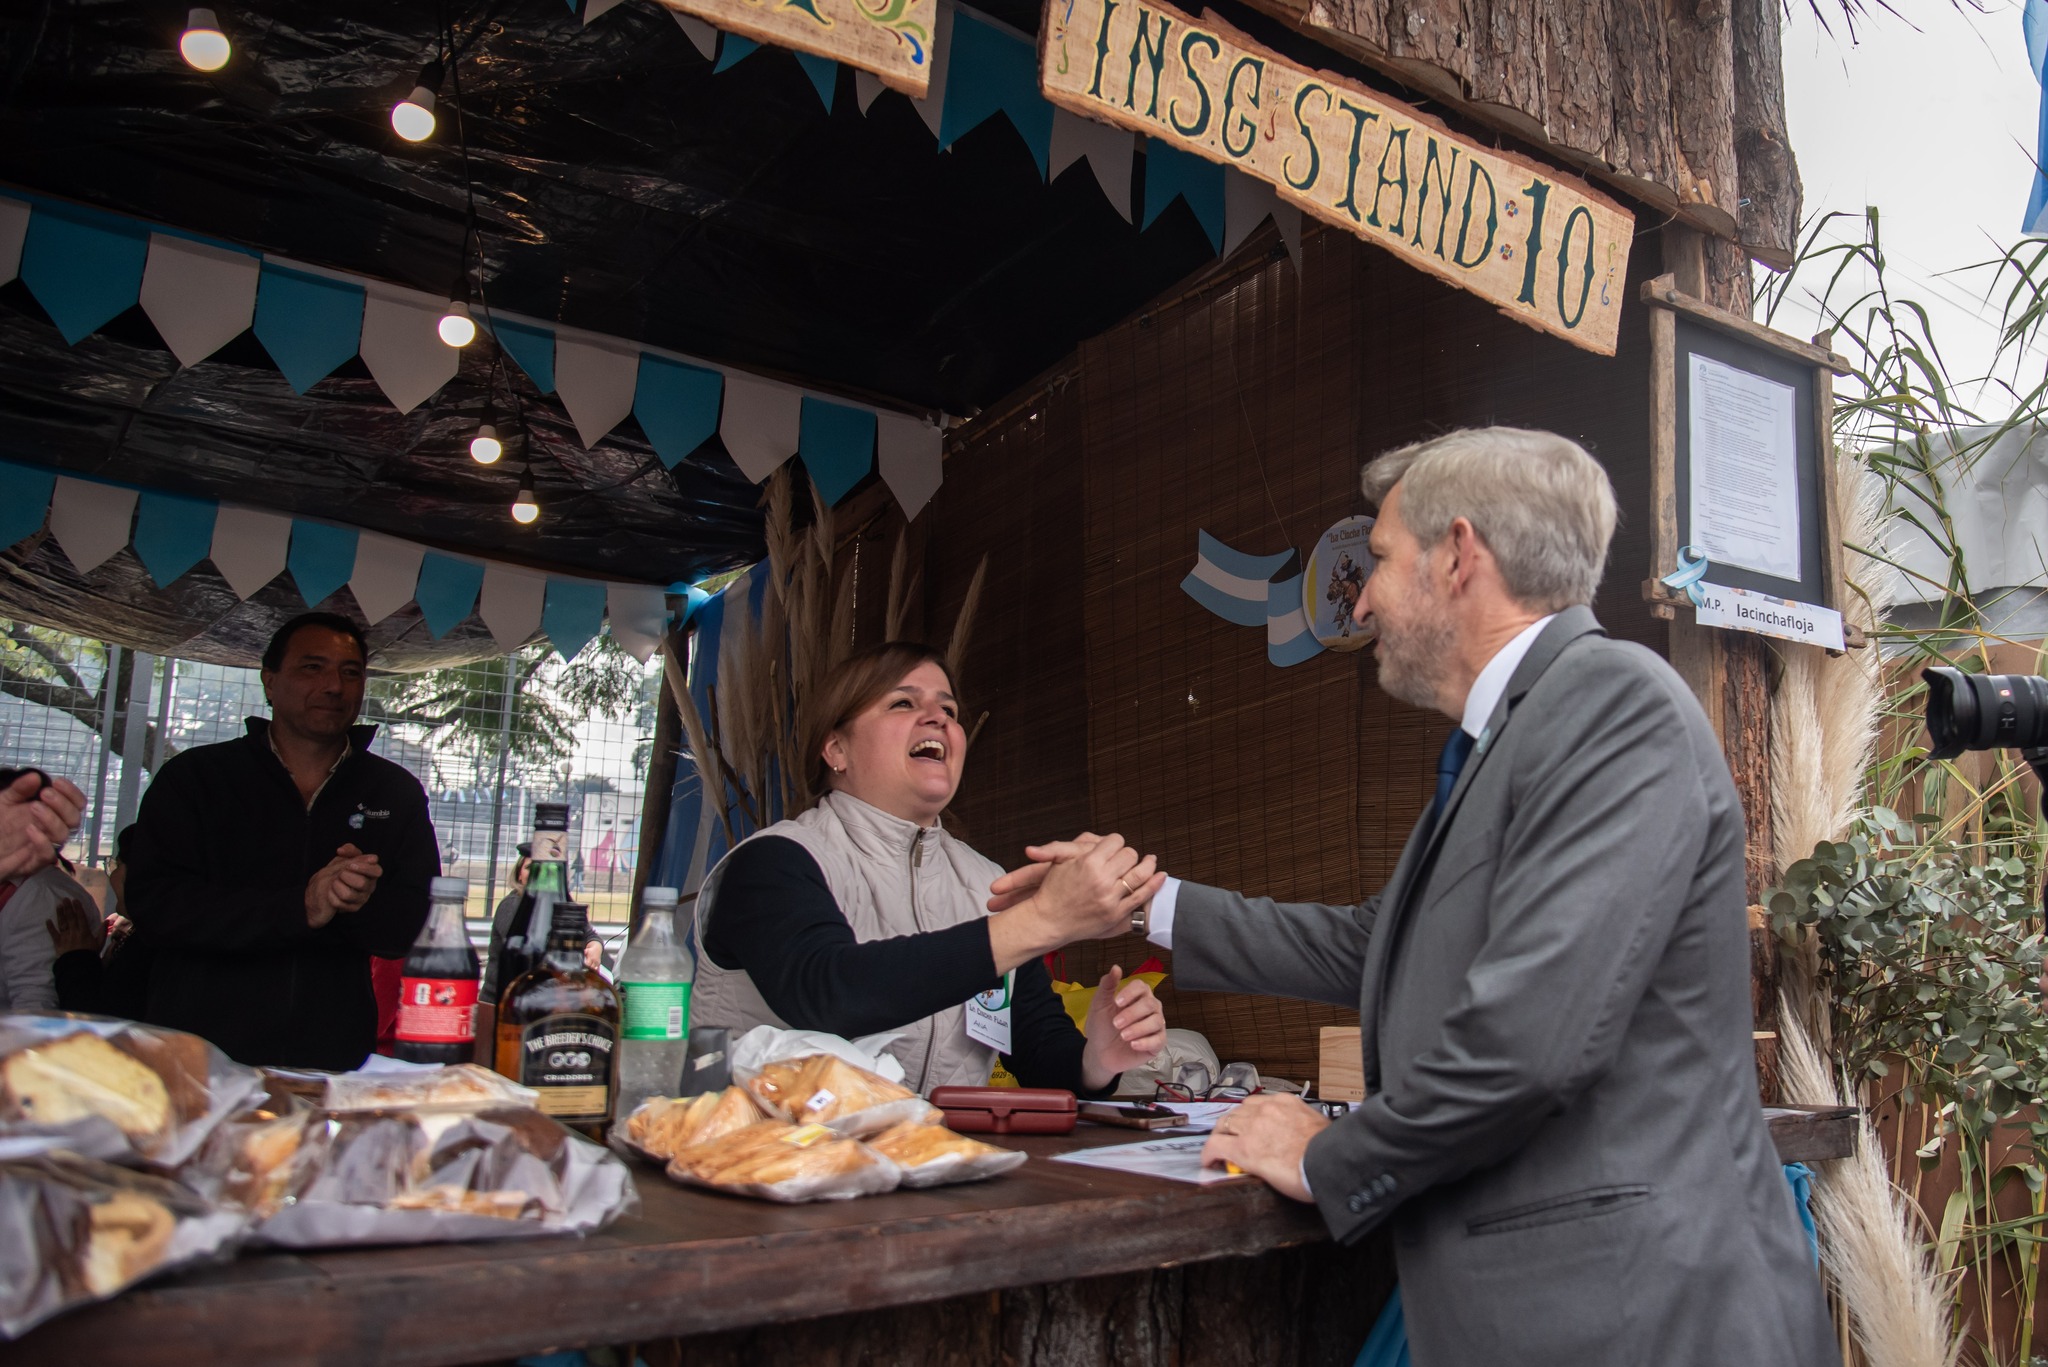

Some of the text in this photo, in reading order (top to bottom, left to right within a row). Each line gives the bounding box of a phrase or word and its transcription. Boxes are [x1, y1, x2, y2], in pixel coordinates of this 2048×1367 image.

[1283, 83, 1498, 266] STAND
[1516, 178, 1596, 328] 10
[526, 1032, 614, 1053] THE BREEDER'S CHOICE
